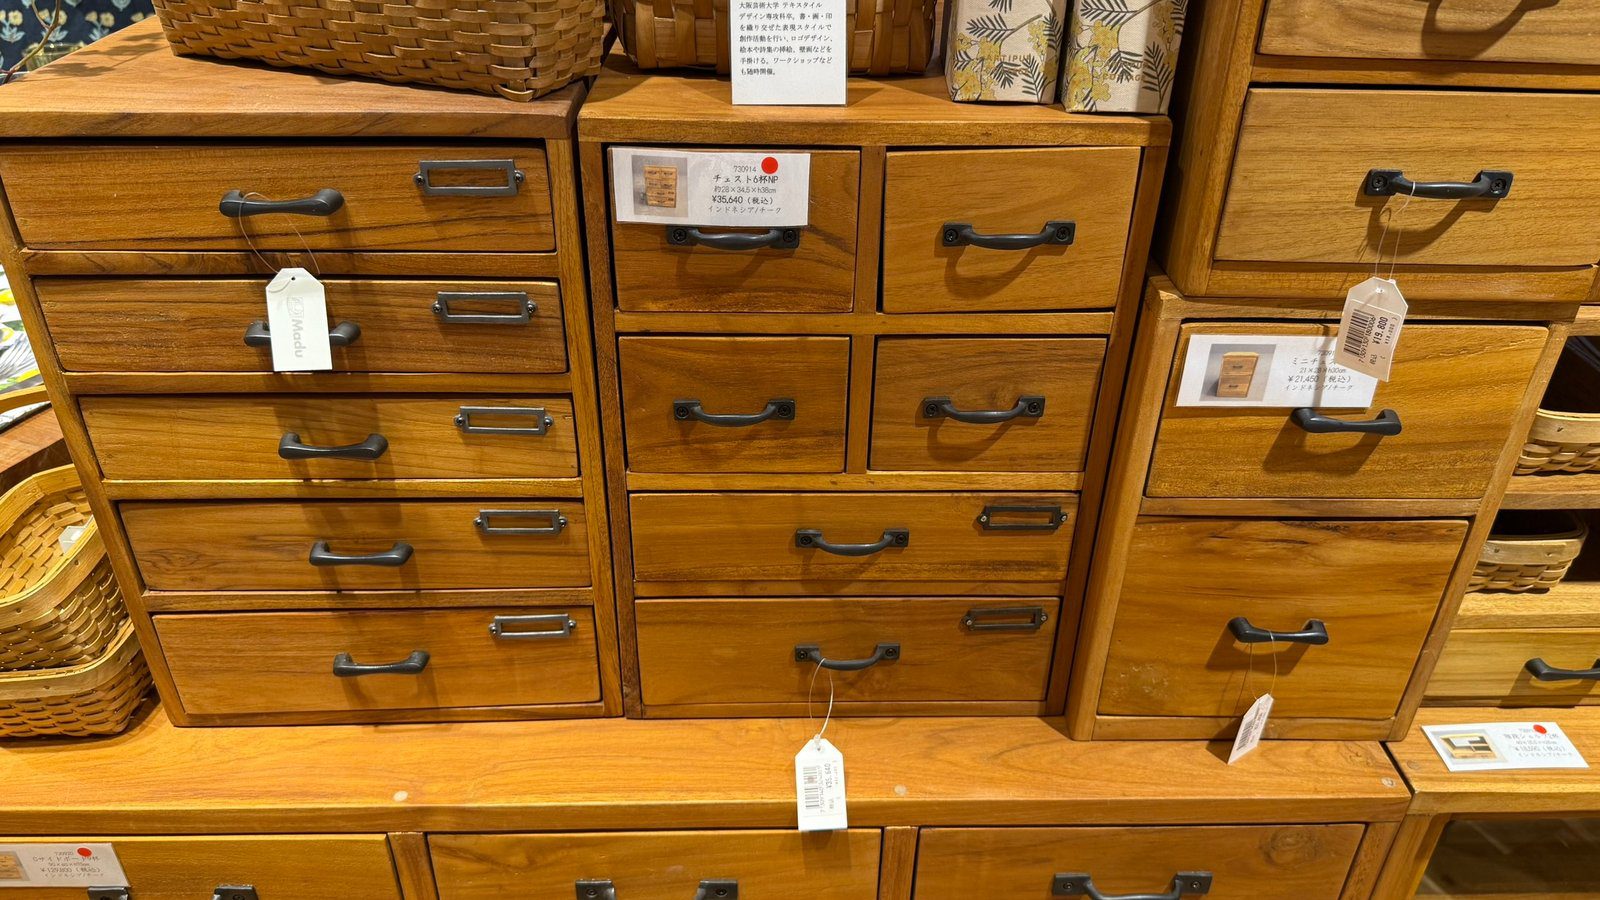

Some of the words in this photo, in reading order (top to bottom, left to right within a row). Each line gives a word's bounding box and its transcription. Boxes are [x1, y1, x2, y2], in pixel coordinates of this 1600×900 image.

[734, 165, 757, 173] 730914
[712, 174, 779, 184] チェスト6杯NP
[708, 206, 782, 215] インドネシア/チーク
[292, 319, 307, 358] Madu
[1292, 356, 1337, 365] ミニチェス
